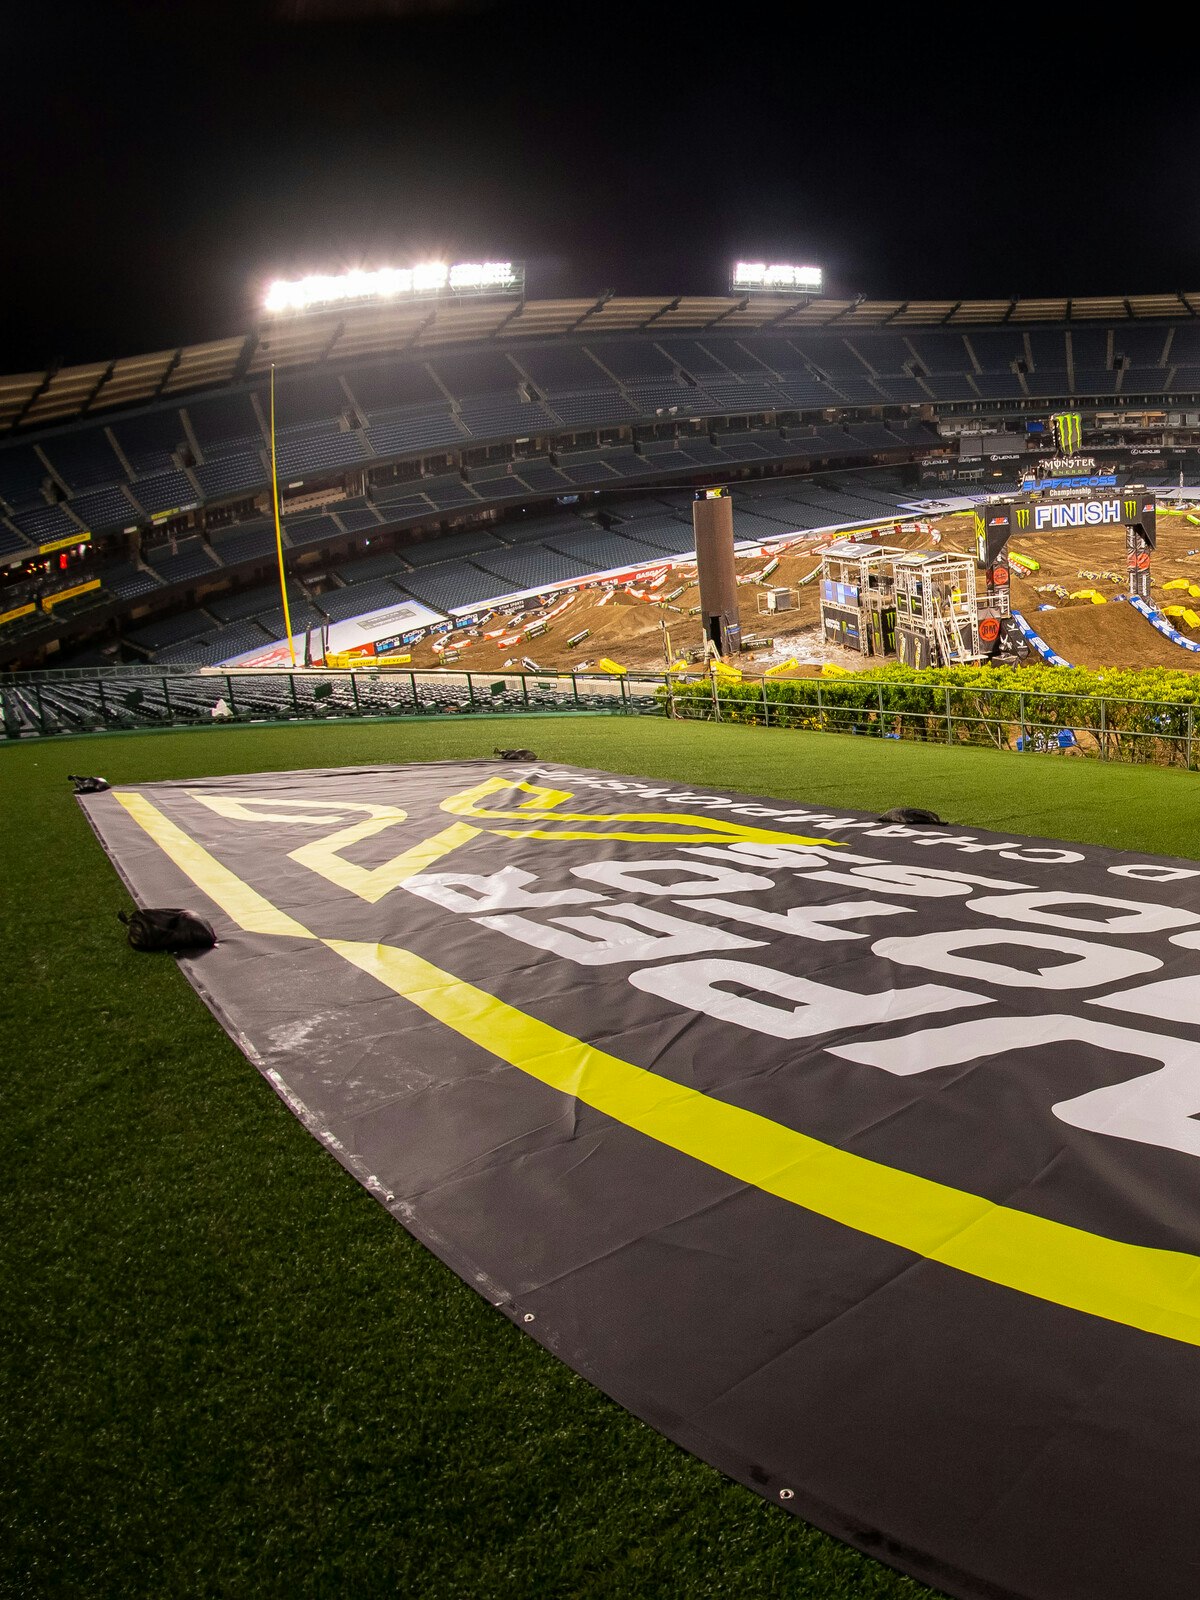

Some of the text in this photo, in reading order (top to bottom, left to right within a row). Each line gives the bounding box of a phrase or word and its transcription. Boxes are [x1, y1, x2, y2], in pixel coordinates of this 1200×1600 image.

[1044, 457, 1096, 469] MONSTER
[1021, 475, 1118, 492] SUPERCROSS
[1049, 487, 1092, 497] Championship
[1035, 500, 1121, 530] FINISH
[456, 613, 478, 624] GoPro
[429, 620, 453, 631] GoPro
[402, 628, 426, 639] GoPro
[375, 636, 400, 647] GoPro
[512, 768, 1086, 865] CHAMPIONSHIP
